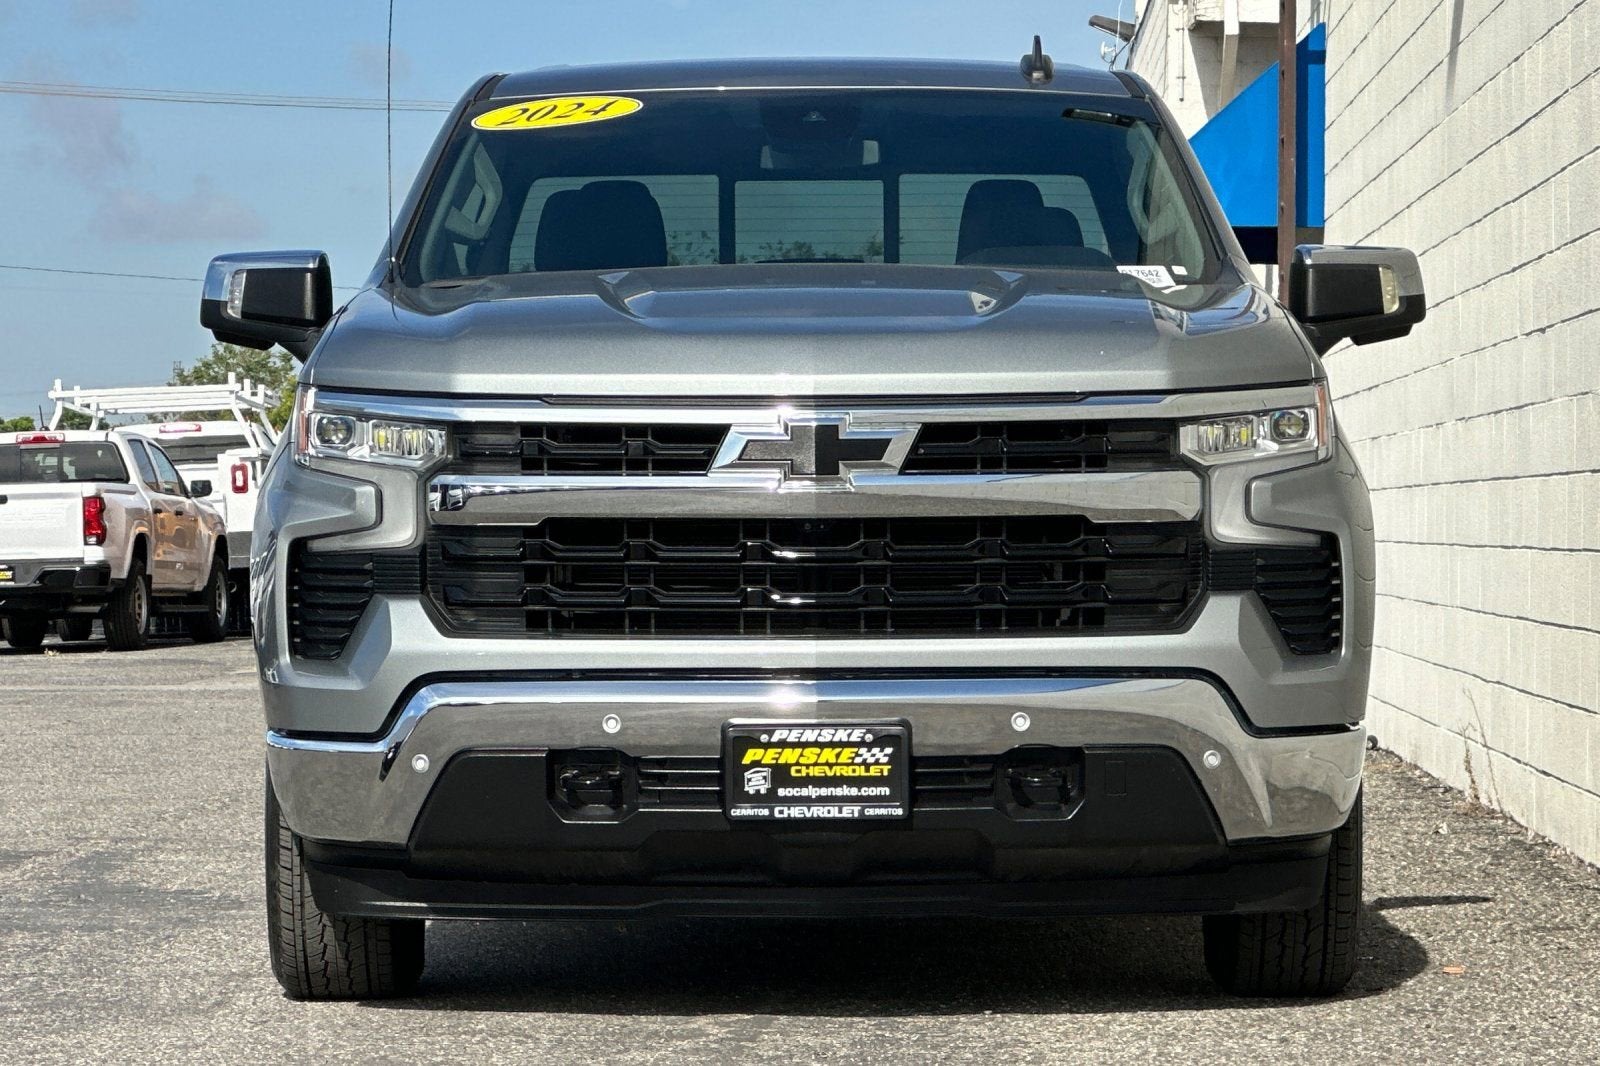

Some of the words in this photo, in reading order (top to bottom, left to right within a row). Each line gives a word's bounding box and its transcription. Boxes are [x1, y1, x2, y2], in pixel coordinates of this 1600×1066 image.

[496, 100, 618, 126] 2024
[770, 729, 866, 742] PENSKE
[741, 747, 858, 764] PENSKE
[790, 765, 892, 776] CHEVROLET
[777, 785, 890, 798] socalpenske.com
[730, 808, 770, 816] CERRITOS
[774, 806, 861, 818] CHEVROLET
[864, 808, 904, 816] CERRITOS
